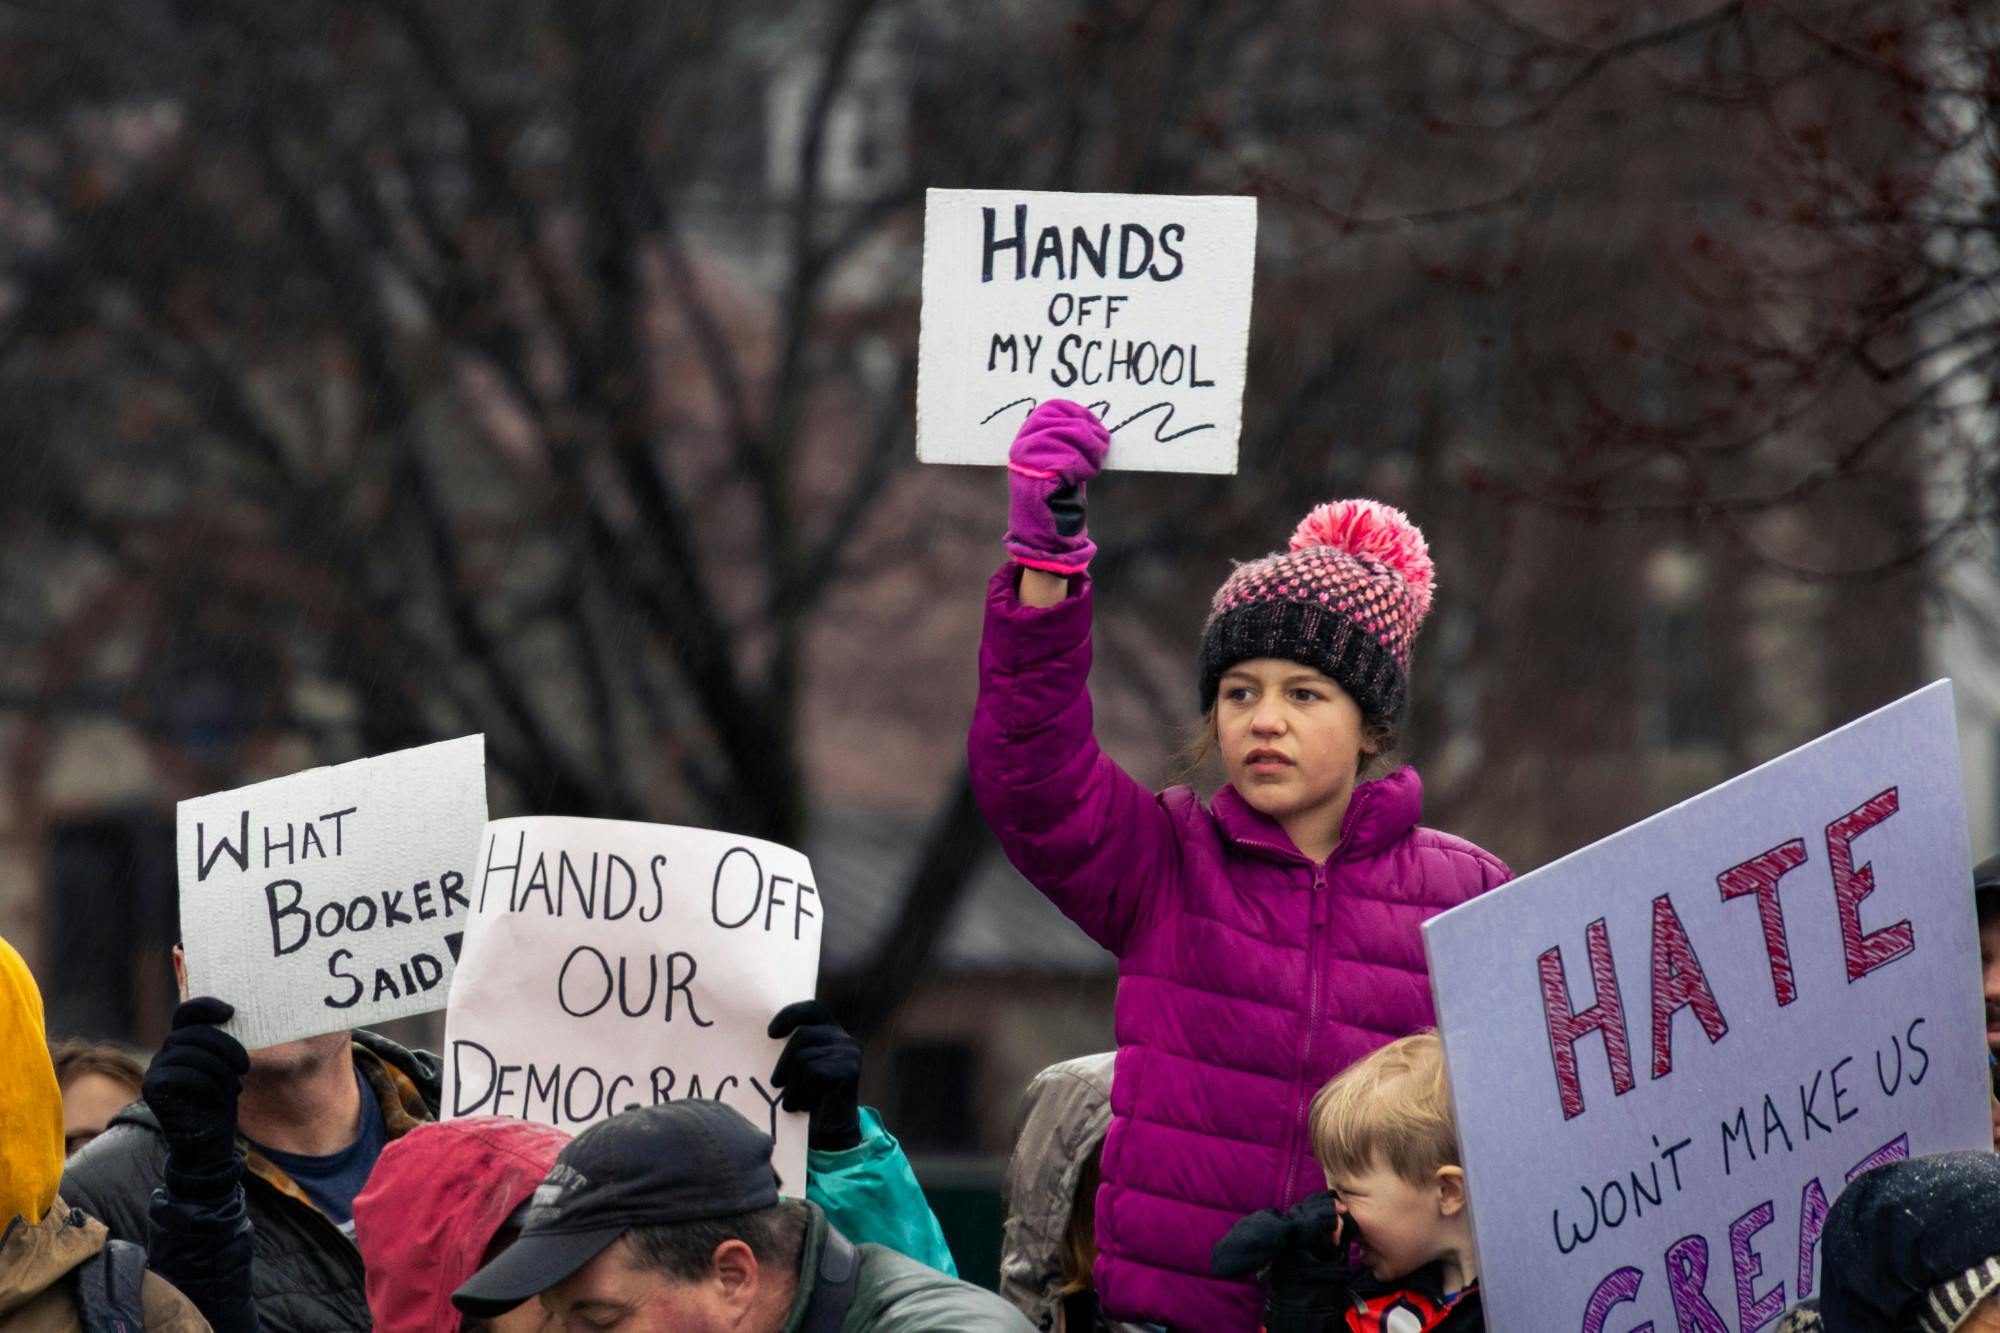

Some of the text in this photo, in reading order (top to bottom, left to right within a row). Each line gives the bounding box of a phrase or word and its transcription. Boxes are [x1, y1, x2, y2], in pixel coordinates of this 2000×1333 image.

[982, 204, 1185, 283] HANDS
[1048, 293, 1128, 328] OFF
[988, 334, 1215, 387] MY SCHOOL
[196, 806, 357, 882] WHAT
[479, 831, 815, 940] HANDS OFF
[265, 870, 470, 957] BOOKER
[1537, 786, 1915, 1121] HATE
[558, 945, 713, 1027] OUR
[1553, 1018, 1929, 1254] WON'T MAKE US
[1582, 1132, 1909, 1333] GREA
